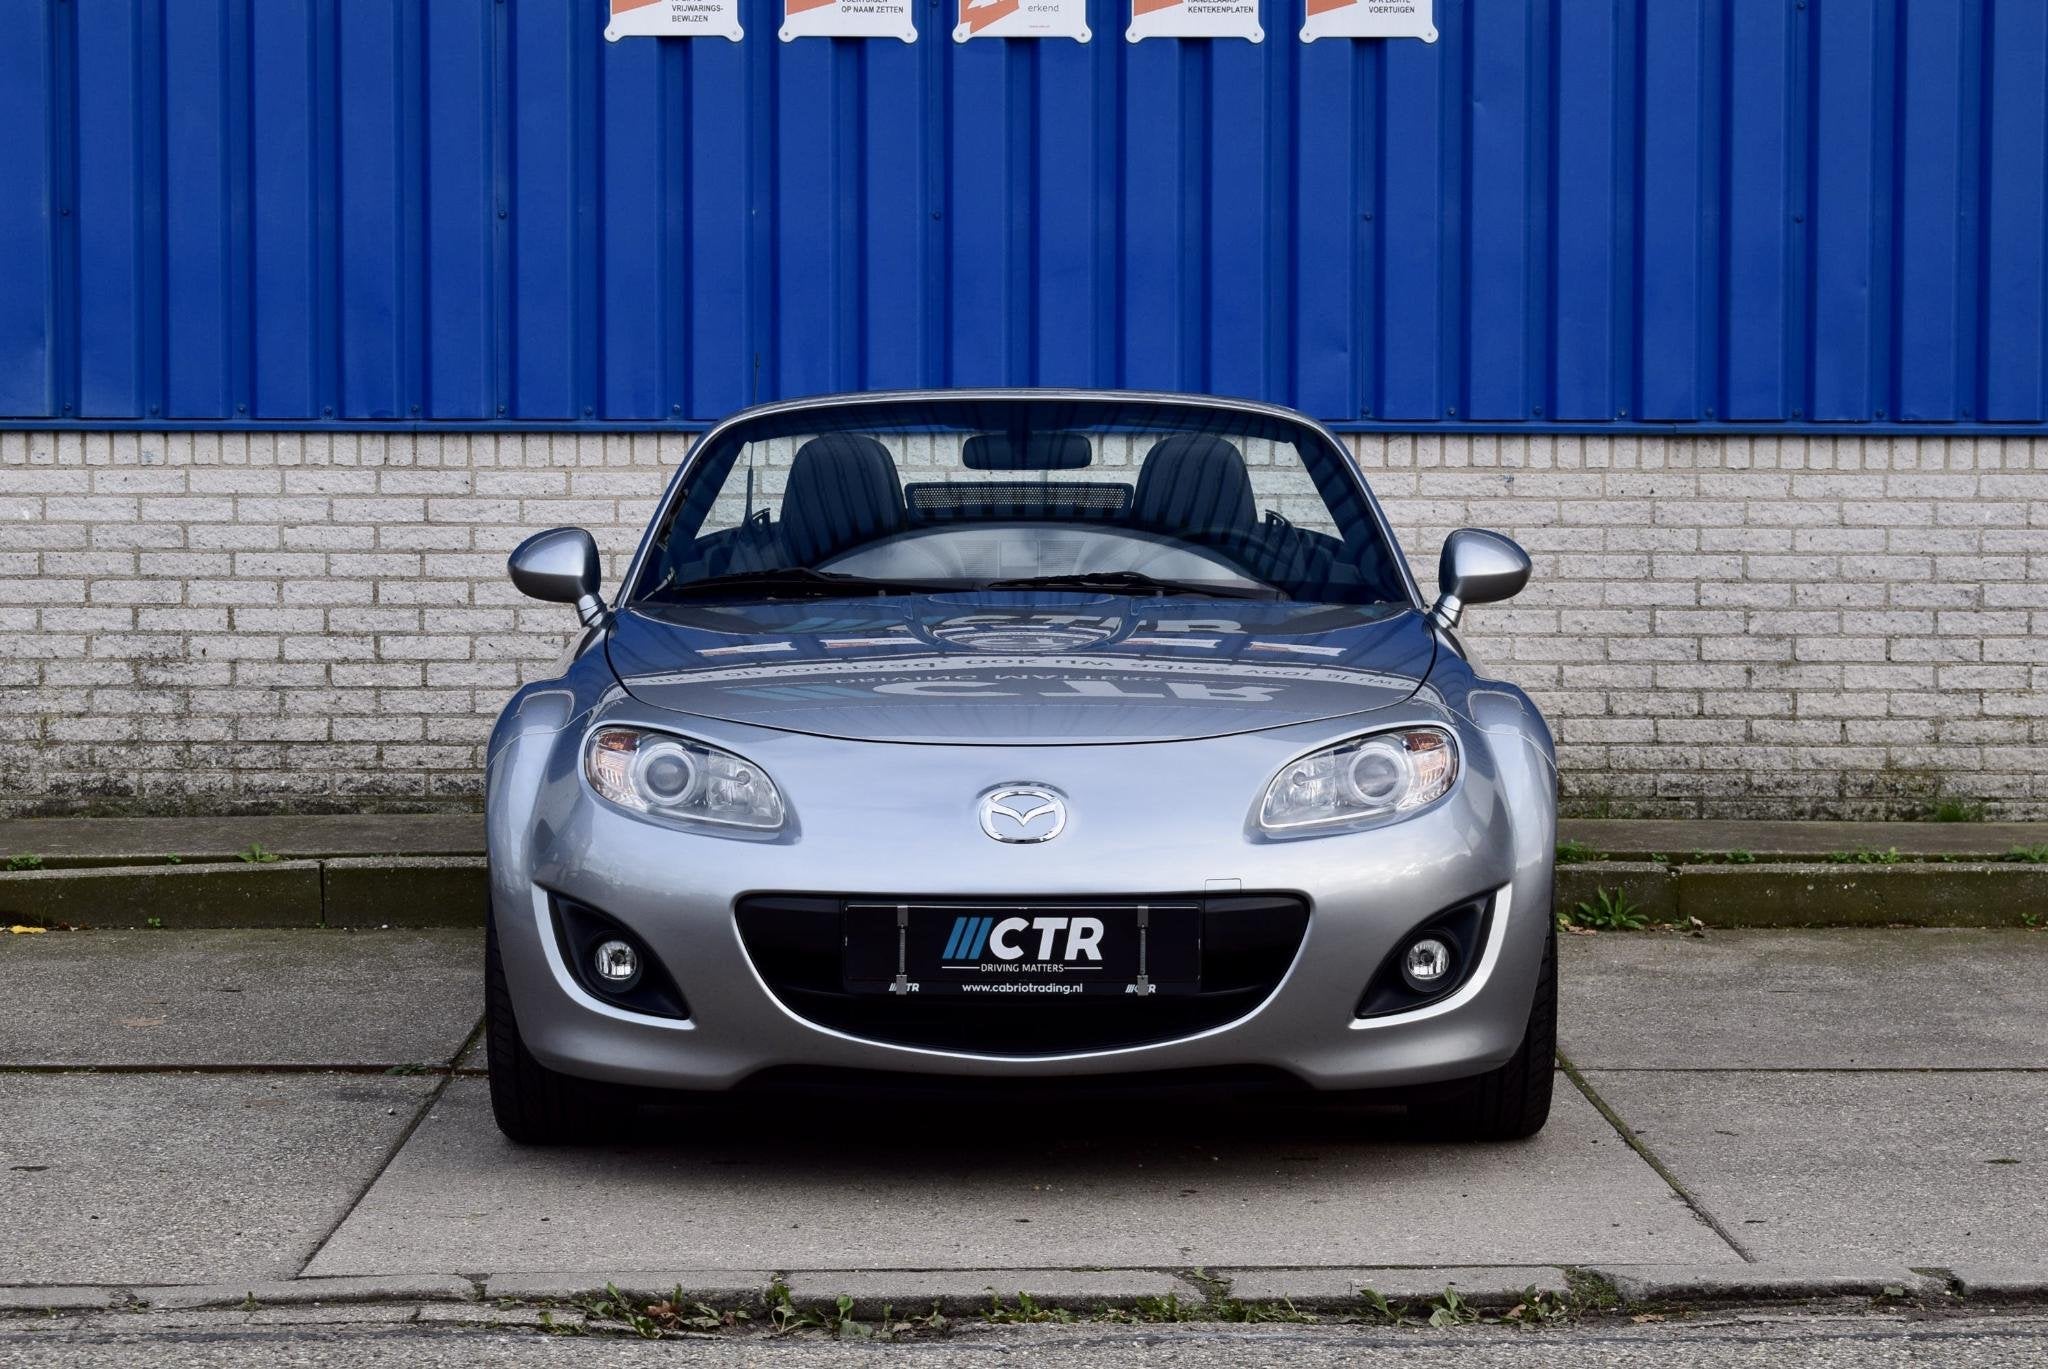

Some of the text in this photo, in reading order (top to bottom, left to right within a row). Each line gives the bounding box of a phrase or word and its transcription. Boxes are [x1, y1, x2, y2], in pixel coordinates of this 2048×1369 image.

[671, 4, 724, 12] VRIJWARINGS-
[841, 5, 904, 14] OP NAAM ZETTEN
[1027, 3, 1060, 12] erkend
[989, 916, 1105, 960] CTR
[980, 963, 1065, 973] DRIVING MATTERS
[961, 982, 1084, 995] www.cabriotrading.nl
